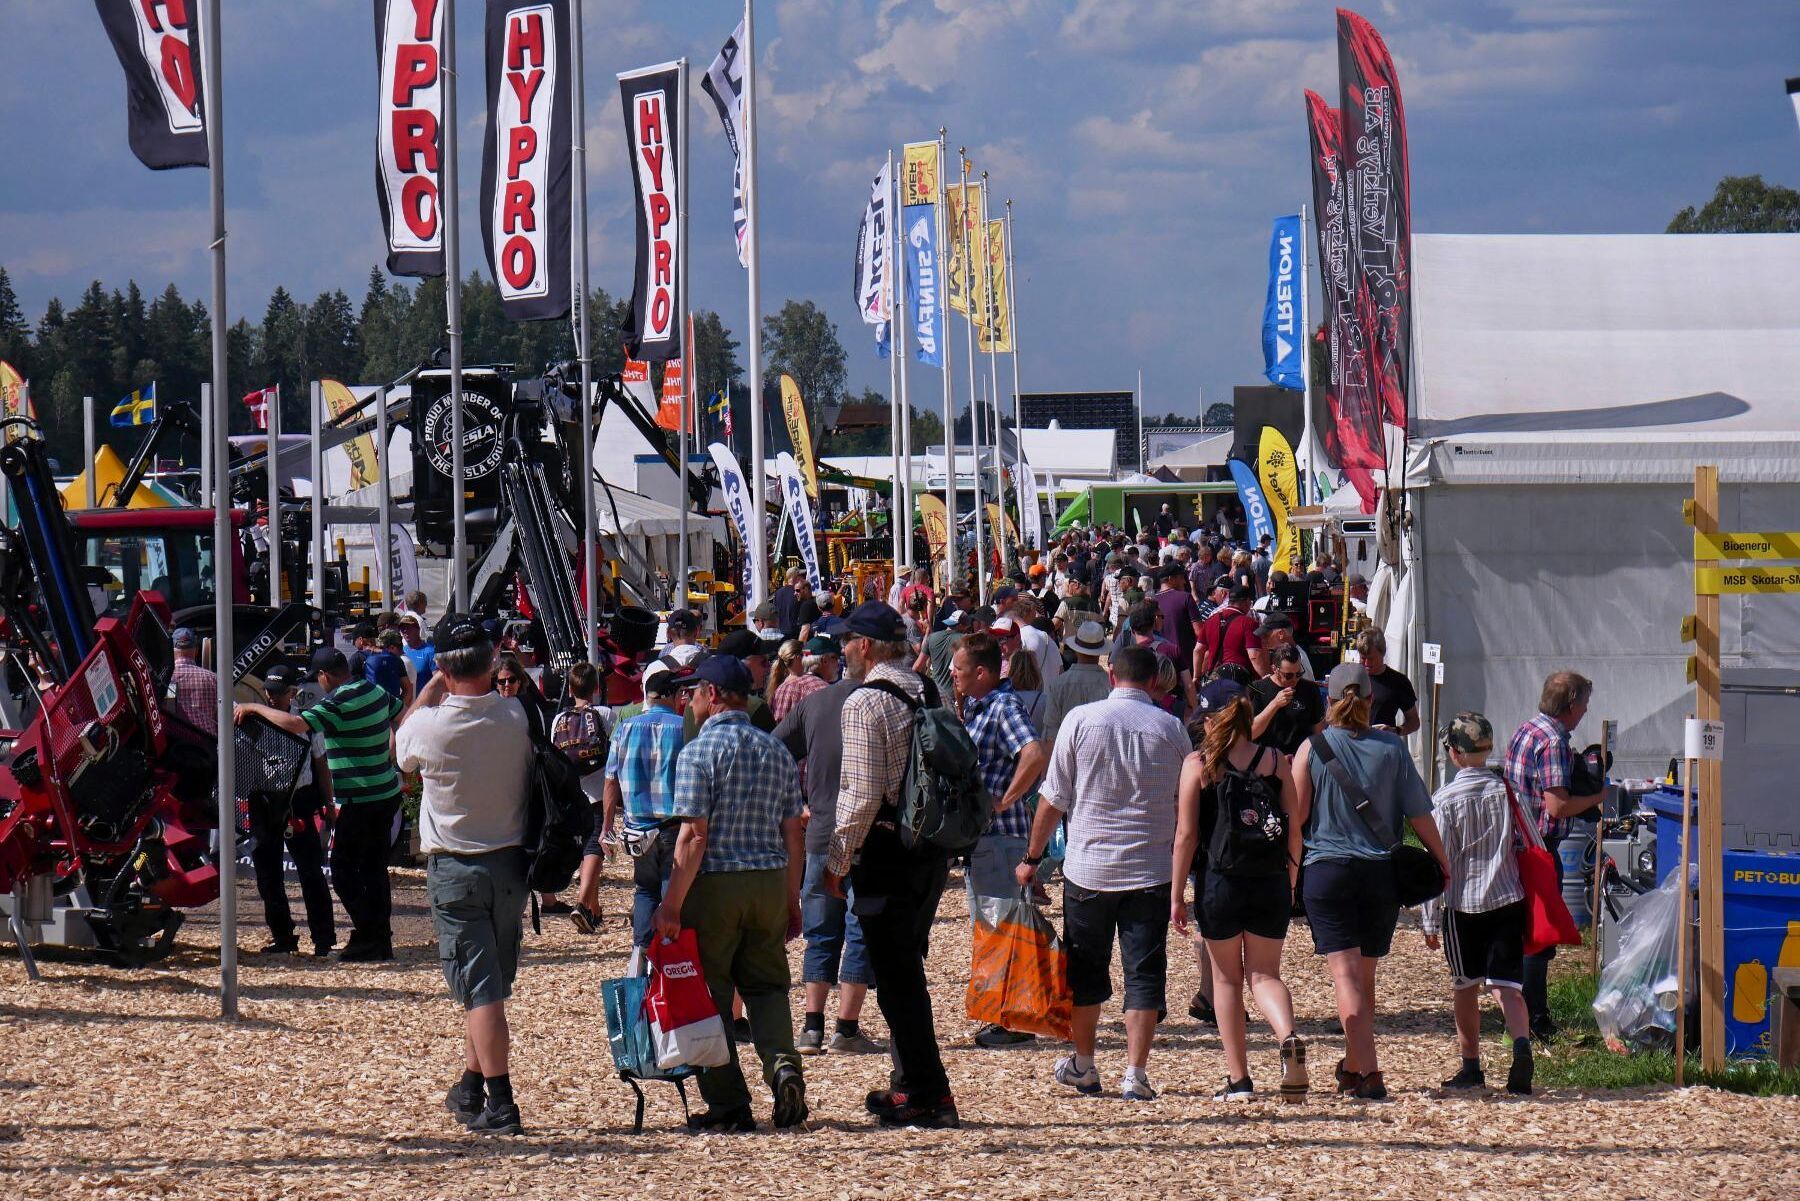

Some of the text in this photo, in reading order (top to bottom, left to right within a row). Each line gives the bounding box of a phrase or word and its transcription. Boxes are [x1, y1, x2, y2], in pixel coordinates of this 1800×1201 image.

[392, 0, 438, 241] YPRO
[501, 14, 545, 290] HYPRO
[639, 97, 671, 335] HYPRO
[425, 392, 504, 442] PROUD MMBER OF
[462, 425, 495, 446] ESLA
[432, 454, 450, 472] THE
[1723, 541, 1771, 552] Bioenergi
[1723, 575, 1746, 585] MSB
[233, 635, 272, 678] HYPRO
[135, 655, 158, 720] HYPRO
[1734, 870, 1764, 883] PET
